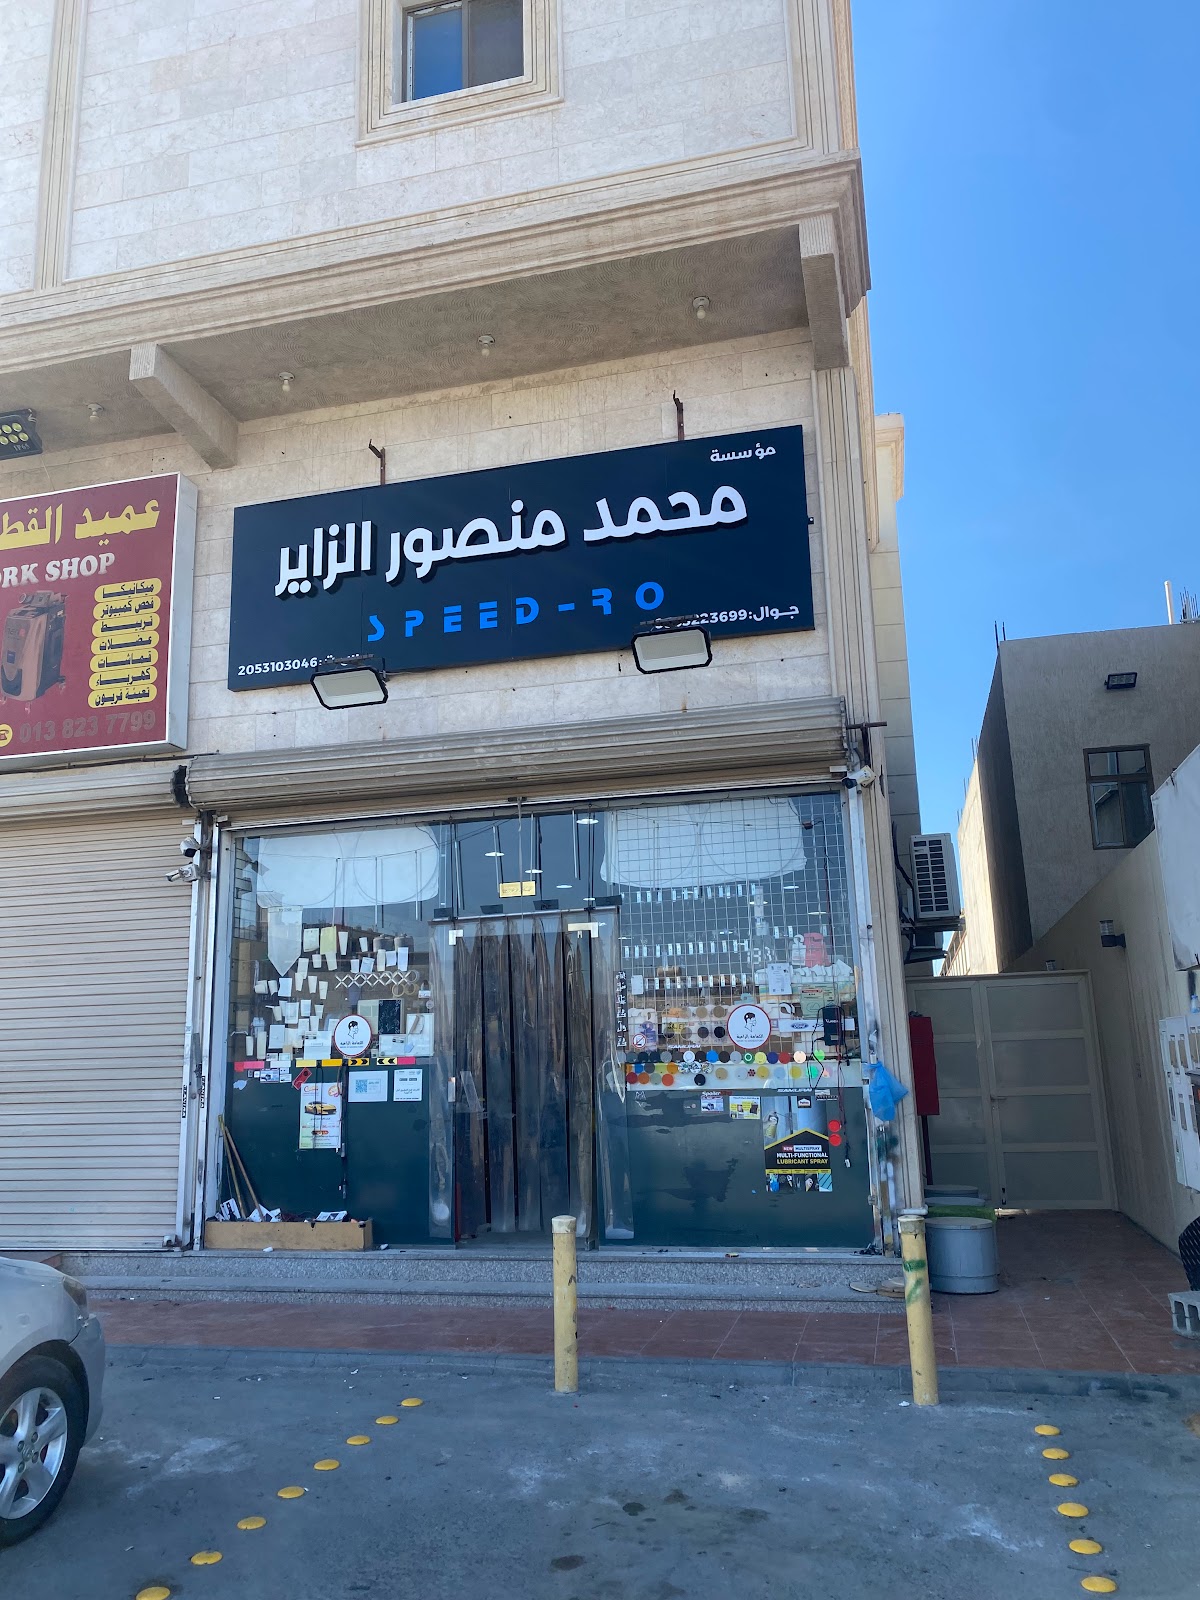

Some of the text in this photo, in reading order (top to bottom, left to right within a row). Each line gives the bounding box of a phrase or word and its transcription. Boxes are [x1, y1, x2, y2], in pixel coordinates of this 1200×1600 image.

[710, 442, 776, 463] مؤسسة
[75, 499, 161, 546] عميد
[274, 485, 748, 597] محمد منصور الزاير
[0, 552, 115, 588] RK SHOP
[100, 597, 154, 618] فحص كمبيوتر
[95, 667, 151, 686] كهرباء
[94, 687, 150, 707] تعبئة فريون
[19, 709, 156, 744] 013 823 7799
